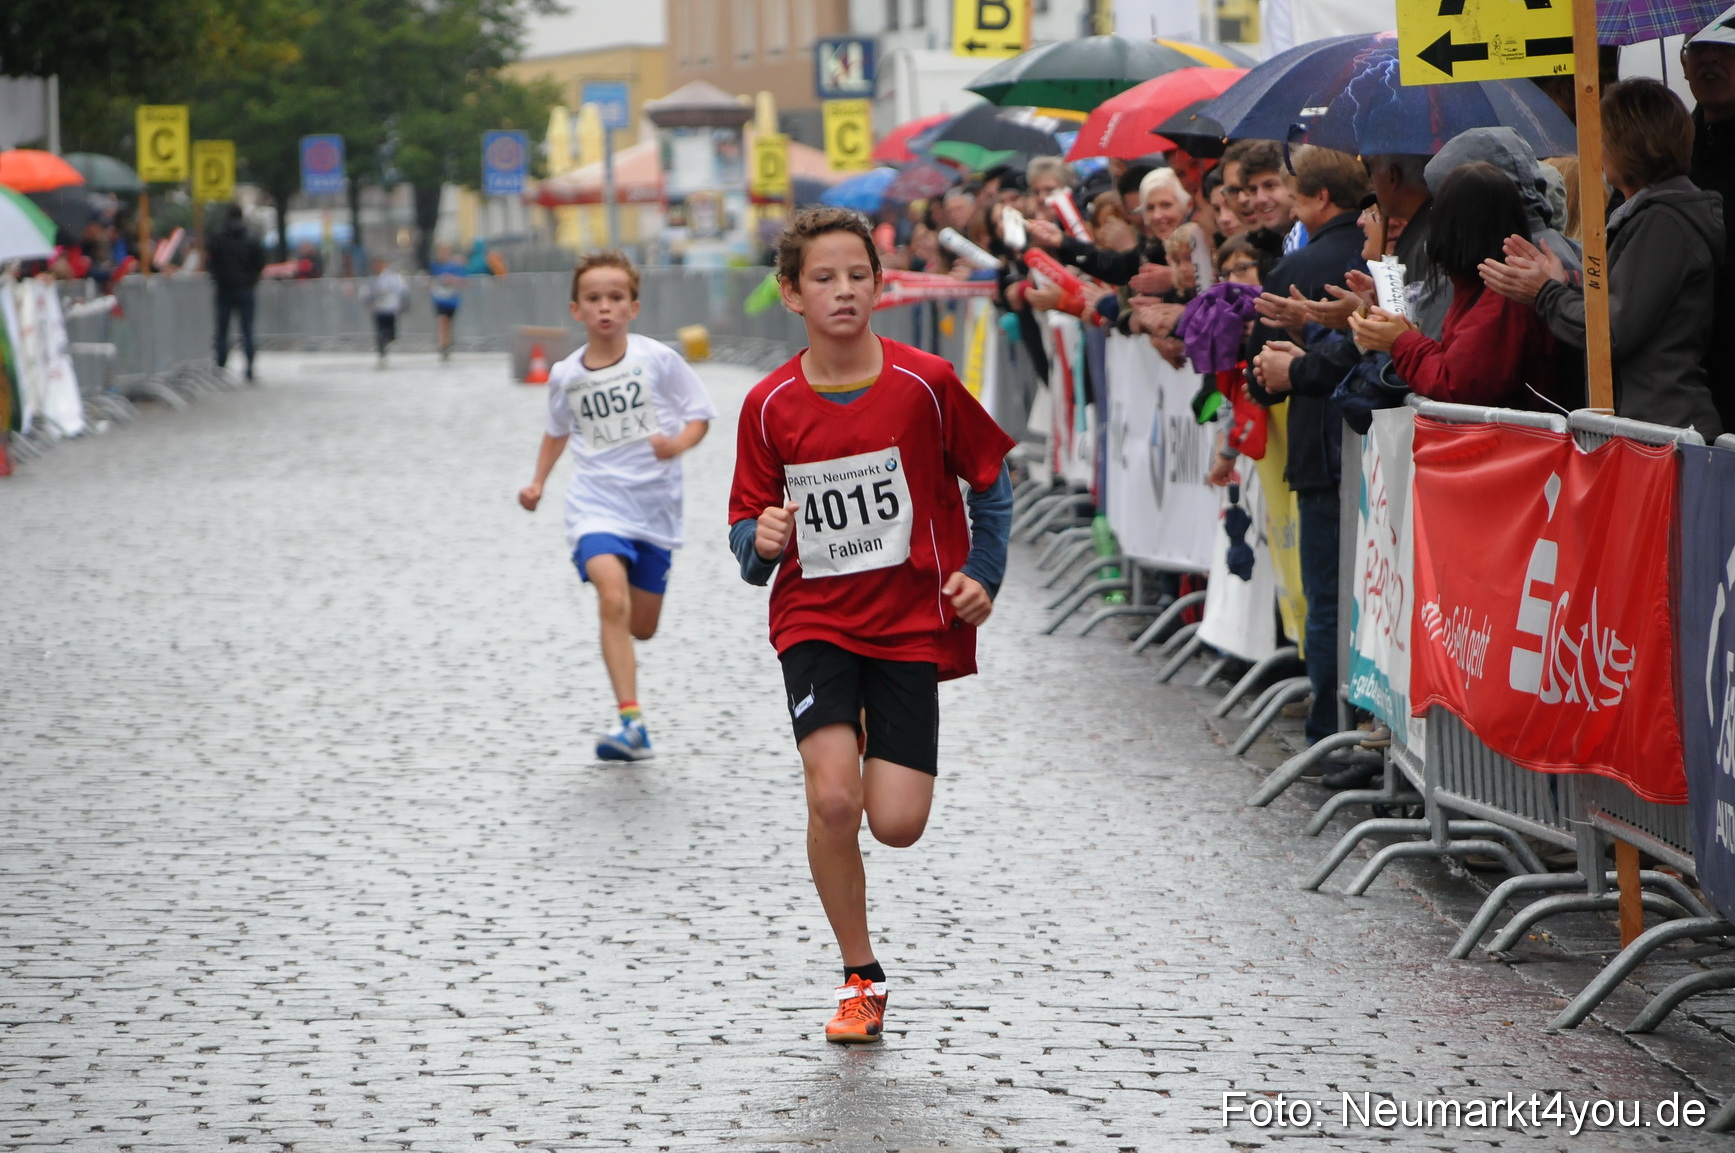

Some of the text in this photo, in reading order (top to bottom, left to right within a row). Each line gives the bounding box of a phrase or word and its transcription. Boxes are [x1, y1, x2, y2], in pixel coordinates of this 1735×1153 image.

[150, 127, 176, 162] C
[835, 120, 862, 155] C
[580, 381, 644, 421] 4052
[593, 412, 650, 448] ALEX
[788, 464, 881, 487] PARTL Neumarkt
[804, 478, 899, 533] 4015
[828, 537, 883, 560] Fabian
